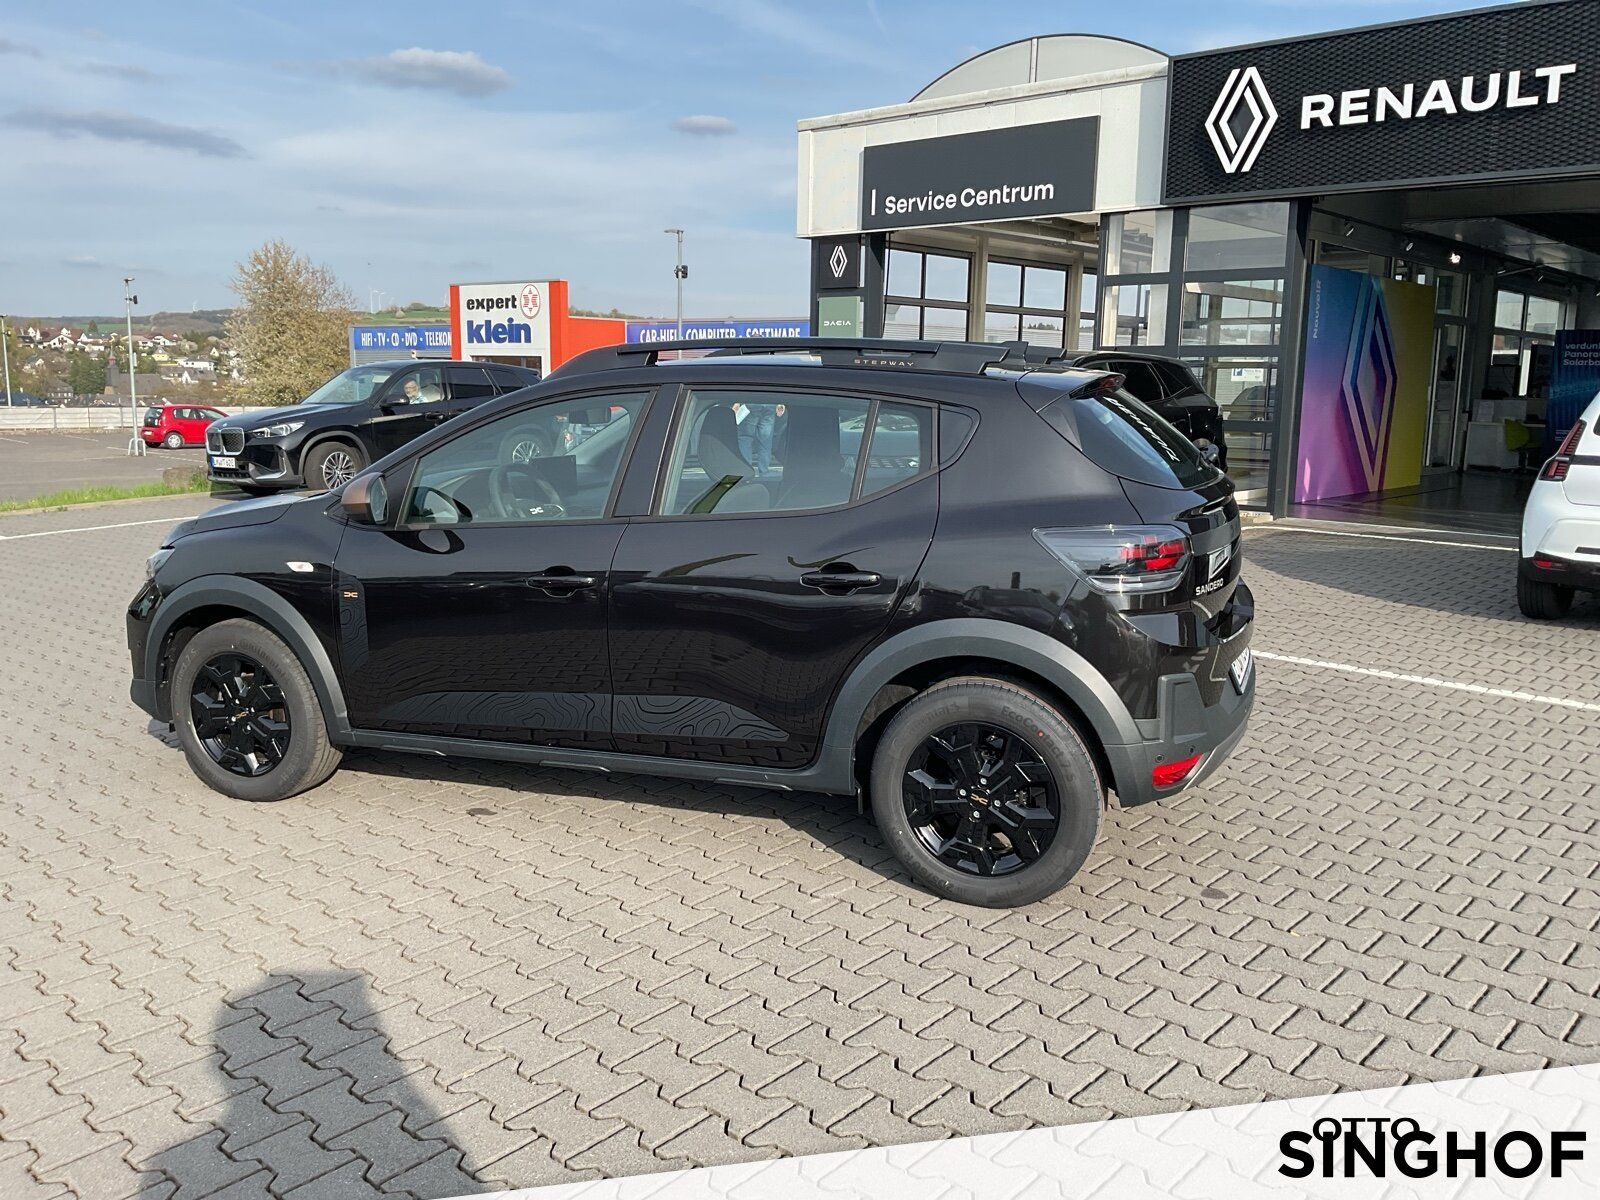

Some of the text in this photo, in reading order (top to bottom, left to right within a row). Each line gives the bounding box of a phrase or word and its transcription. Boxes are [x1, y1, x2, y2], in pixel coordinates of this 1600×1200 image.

[1300, 63, 1577, 130] RENAULT
[885, 182, 1055, 215] Service Centrum
[466, 294, 517, 313] expert
[361, 332, 373, 347] HIFI
[377, 332, 386, 347] TV
[404, 332, 418, 347] DVD
[466, 317, 532, 344] klein
[854, 359, 914, 367] STEPWAY
[1564, 350, 1600, 358] Panora
[1195, 577, 1224, 596] SANDERO
